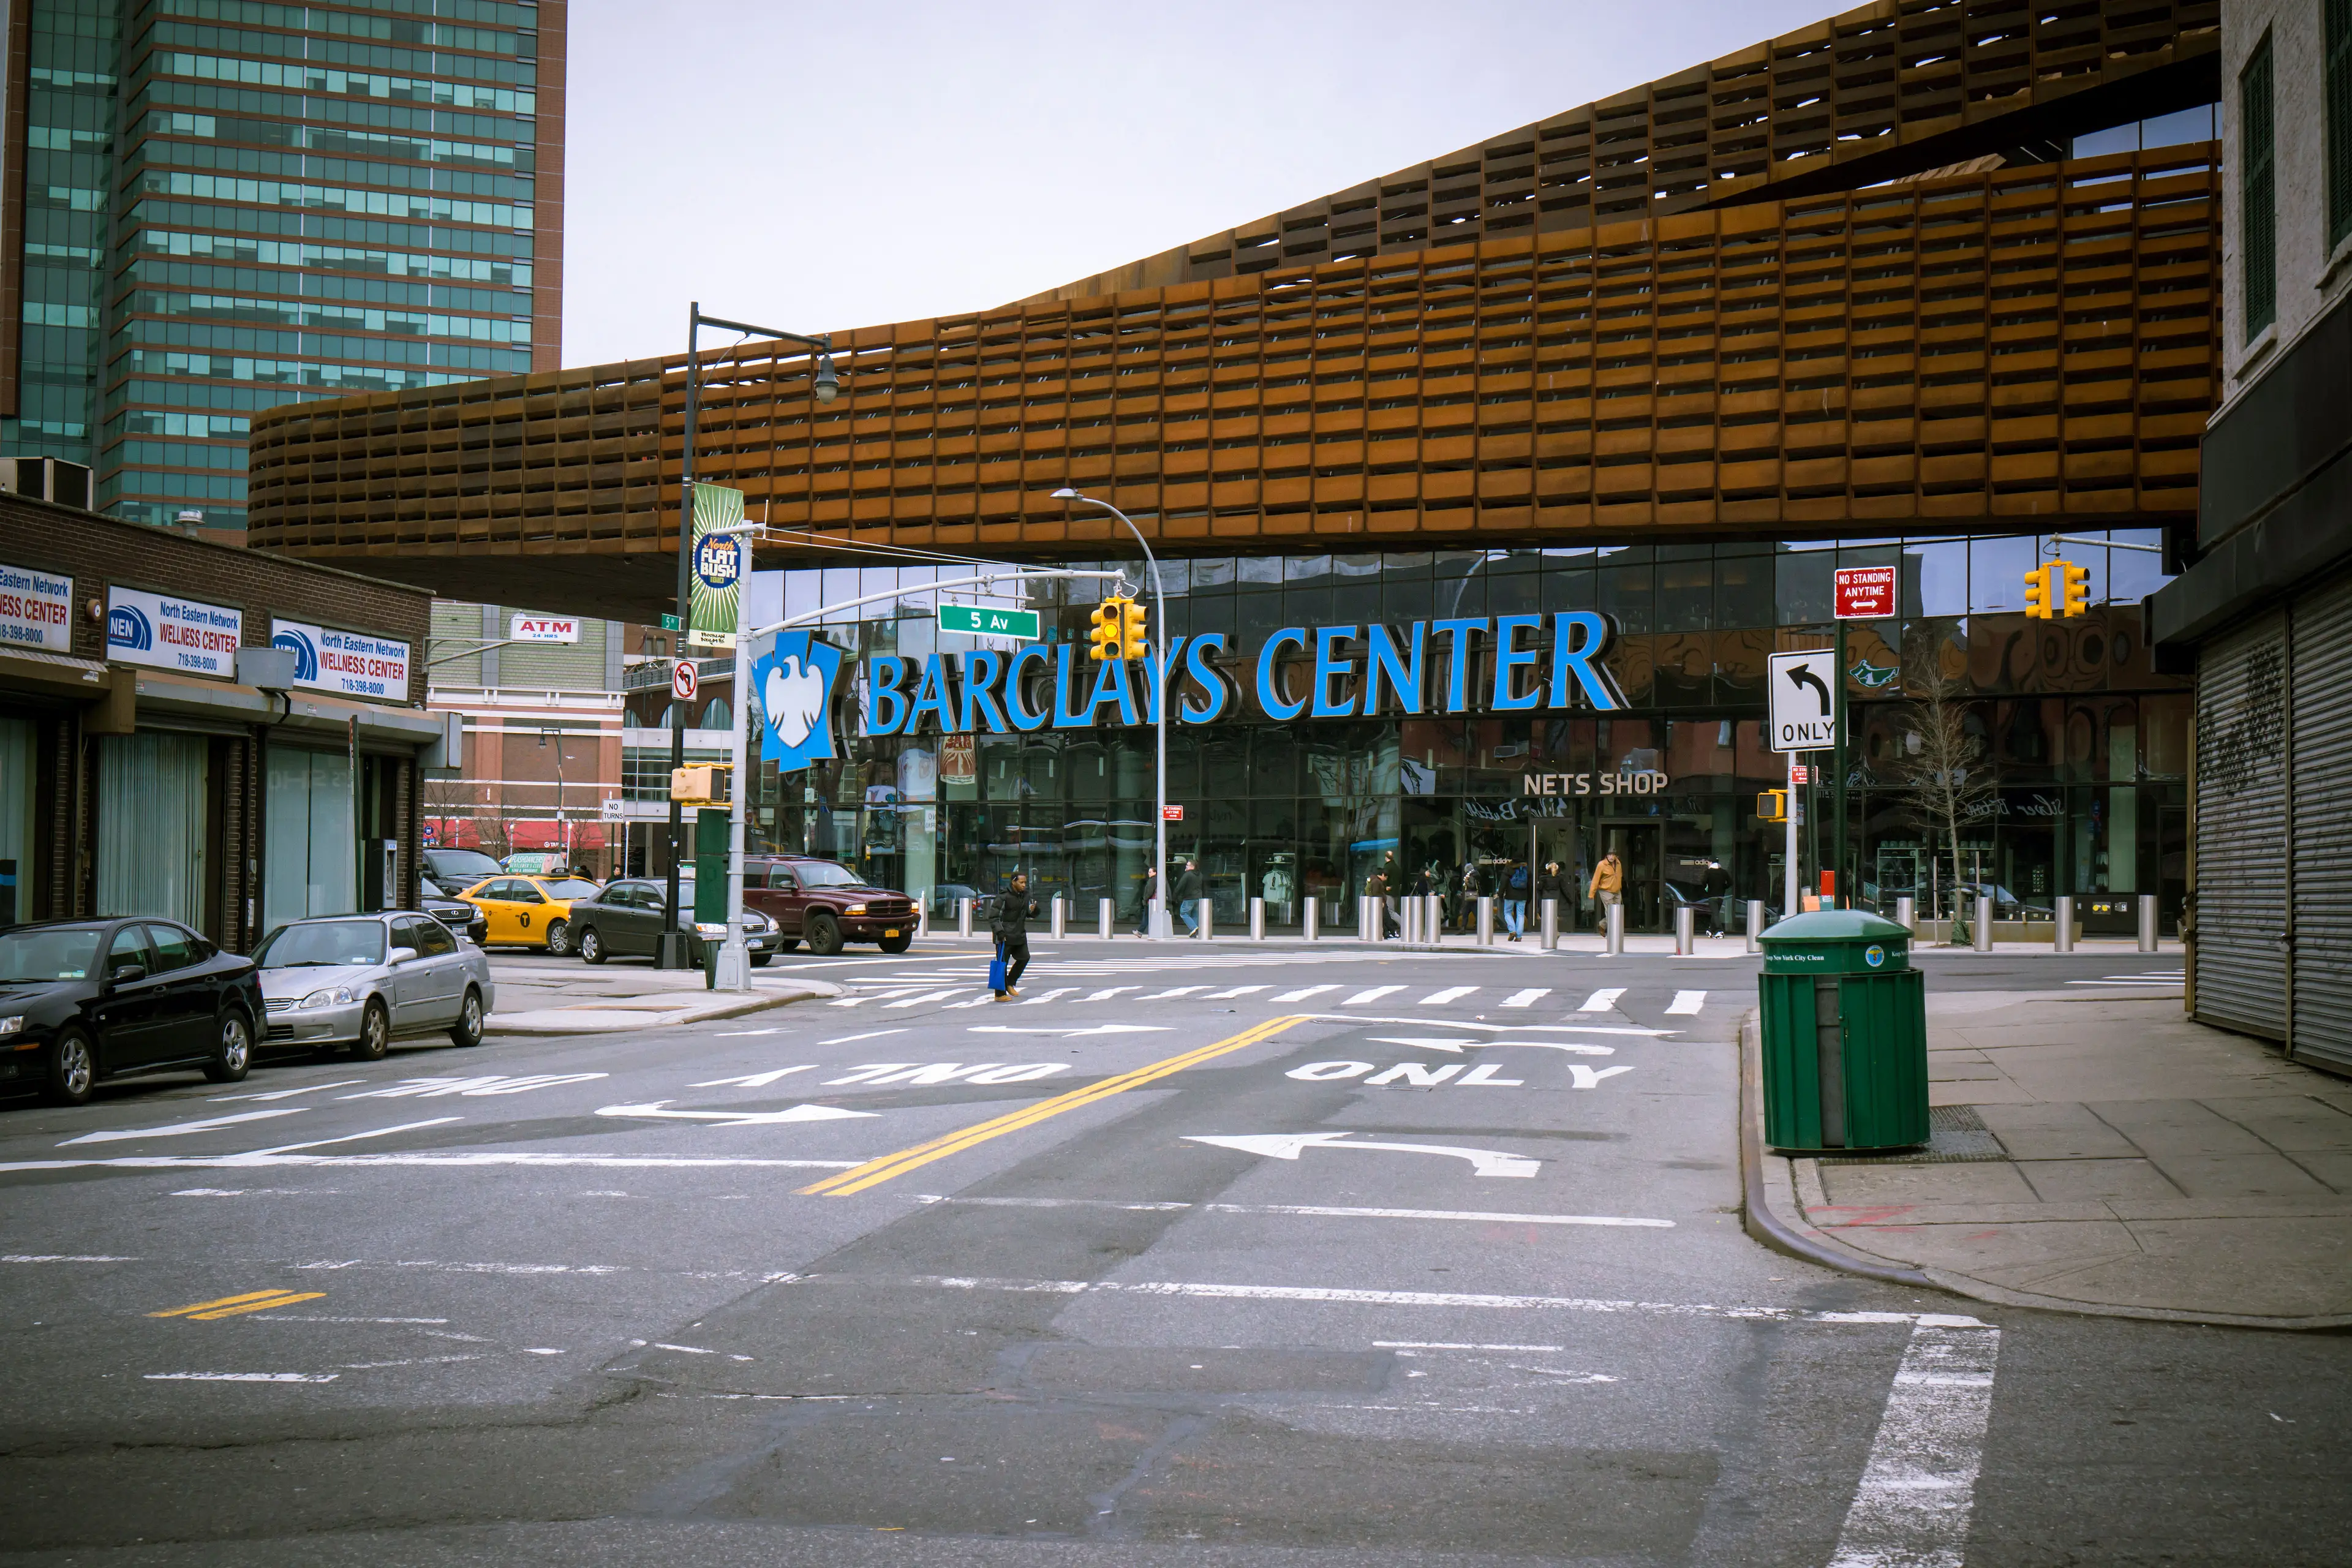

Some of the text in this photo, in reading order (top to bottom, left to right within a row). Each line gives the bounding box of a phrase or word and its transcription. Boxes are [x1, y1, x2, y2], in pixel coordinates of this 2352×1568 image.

[704, 537, 734, 551] North
[701, 548, 737, 565] FLAT
[701, 562, 736, 578] BUSH
[1839, 572, 1891, 584] NO STANDING
[32, 576, 67, 597] Network
[1845, 586, 1885, 597] ANYTIME
[24, 598, 67, 625] CENTER
[160, 601, 238, 630] North Eastern Network
[970, 612, 1008, 630] 5 Av
[110, 617, 134, 638] NEN
[520, 620, 571, 633] ATM
[666, 616, 670, 628] 5
[160, 622, 237, 654] WELLNESS CENTER
[320, 632, 405, 658] North Eastern Network
[178, 652, 217, 671] 718-398-8000
[320, 651, 366, 675] WELLNESS
[368, 659, 404, 680] CENTER
[1256, 611, 1620, 720] CENTER
[341, 678, 385, 695] 718-398-8000
[866, 633, 1229, 736] BARCLAYS
[1782, 722, 1835, 742] ONLY
[1525, 772, 1668, 795] NETS SHOP
[1284, 1060, 1637, 1088] ONLY
